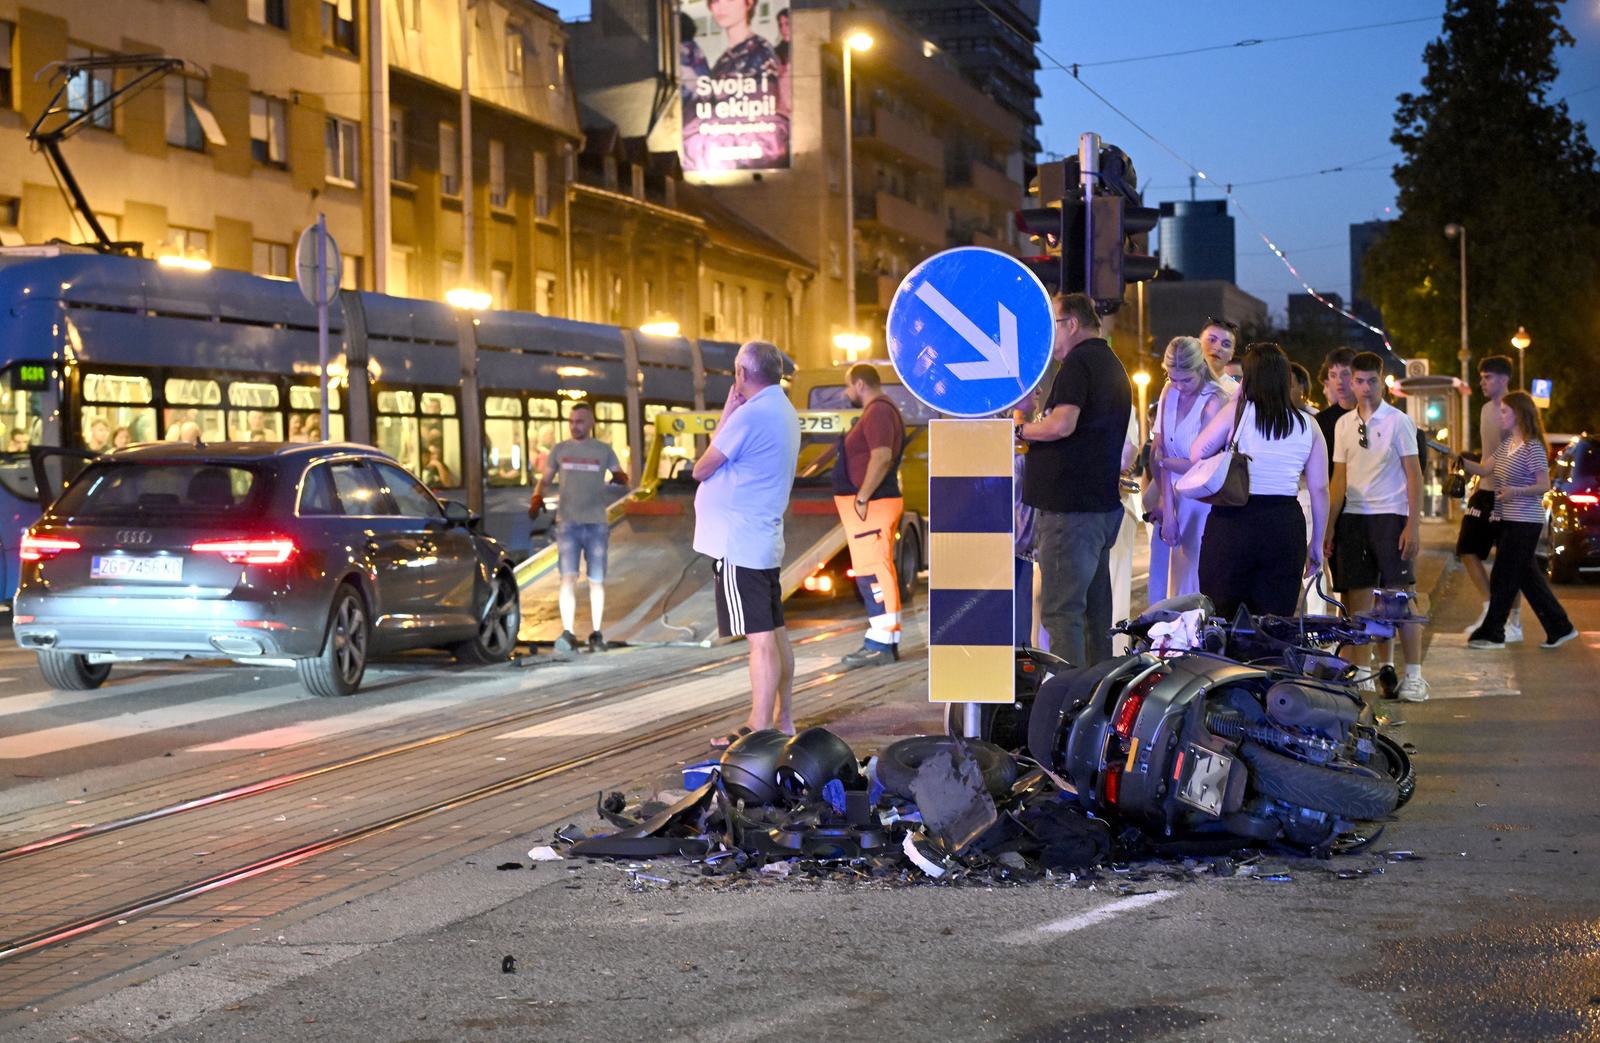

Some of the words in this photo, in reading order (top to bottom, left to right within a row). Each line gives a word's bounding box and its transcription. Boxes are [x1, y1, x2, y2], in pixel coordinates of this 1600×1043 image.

[696, 73, 757, 99] Svoja
[761, 71, 768, 93] i
[696, 102, 712, 119] u
[715, 95, 776, 121] ekipi!
